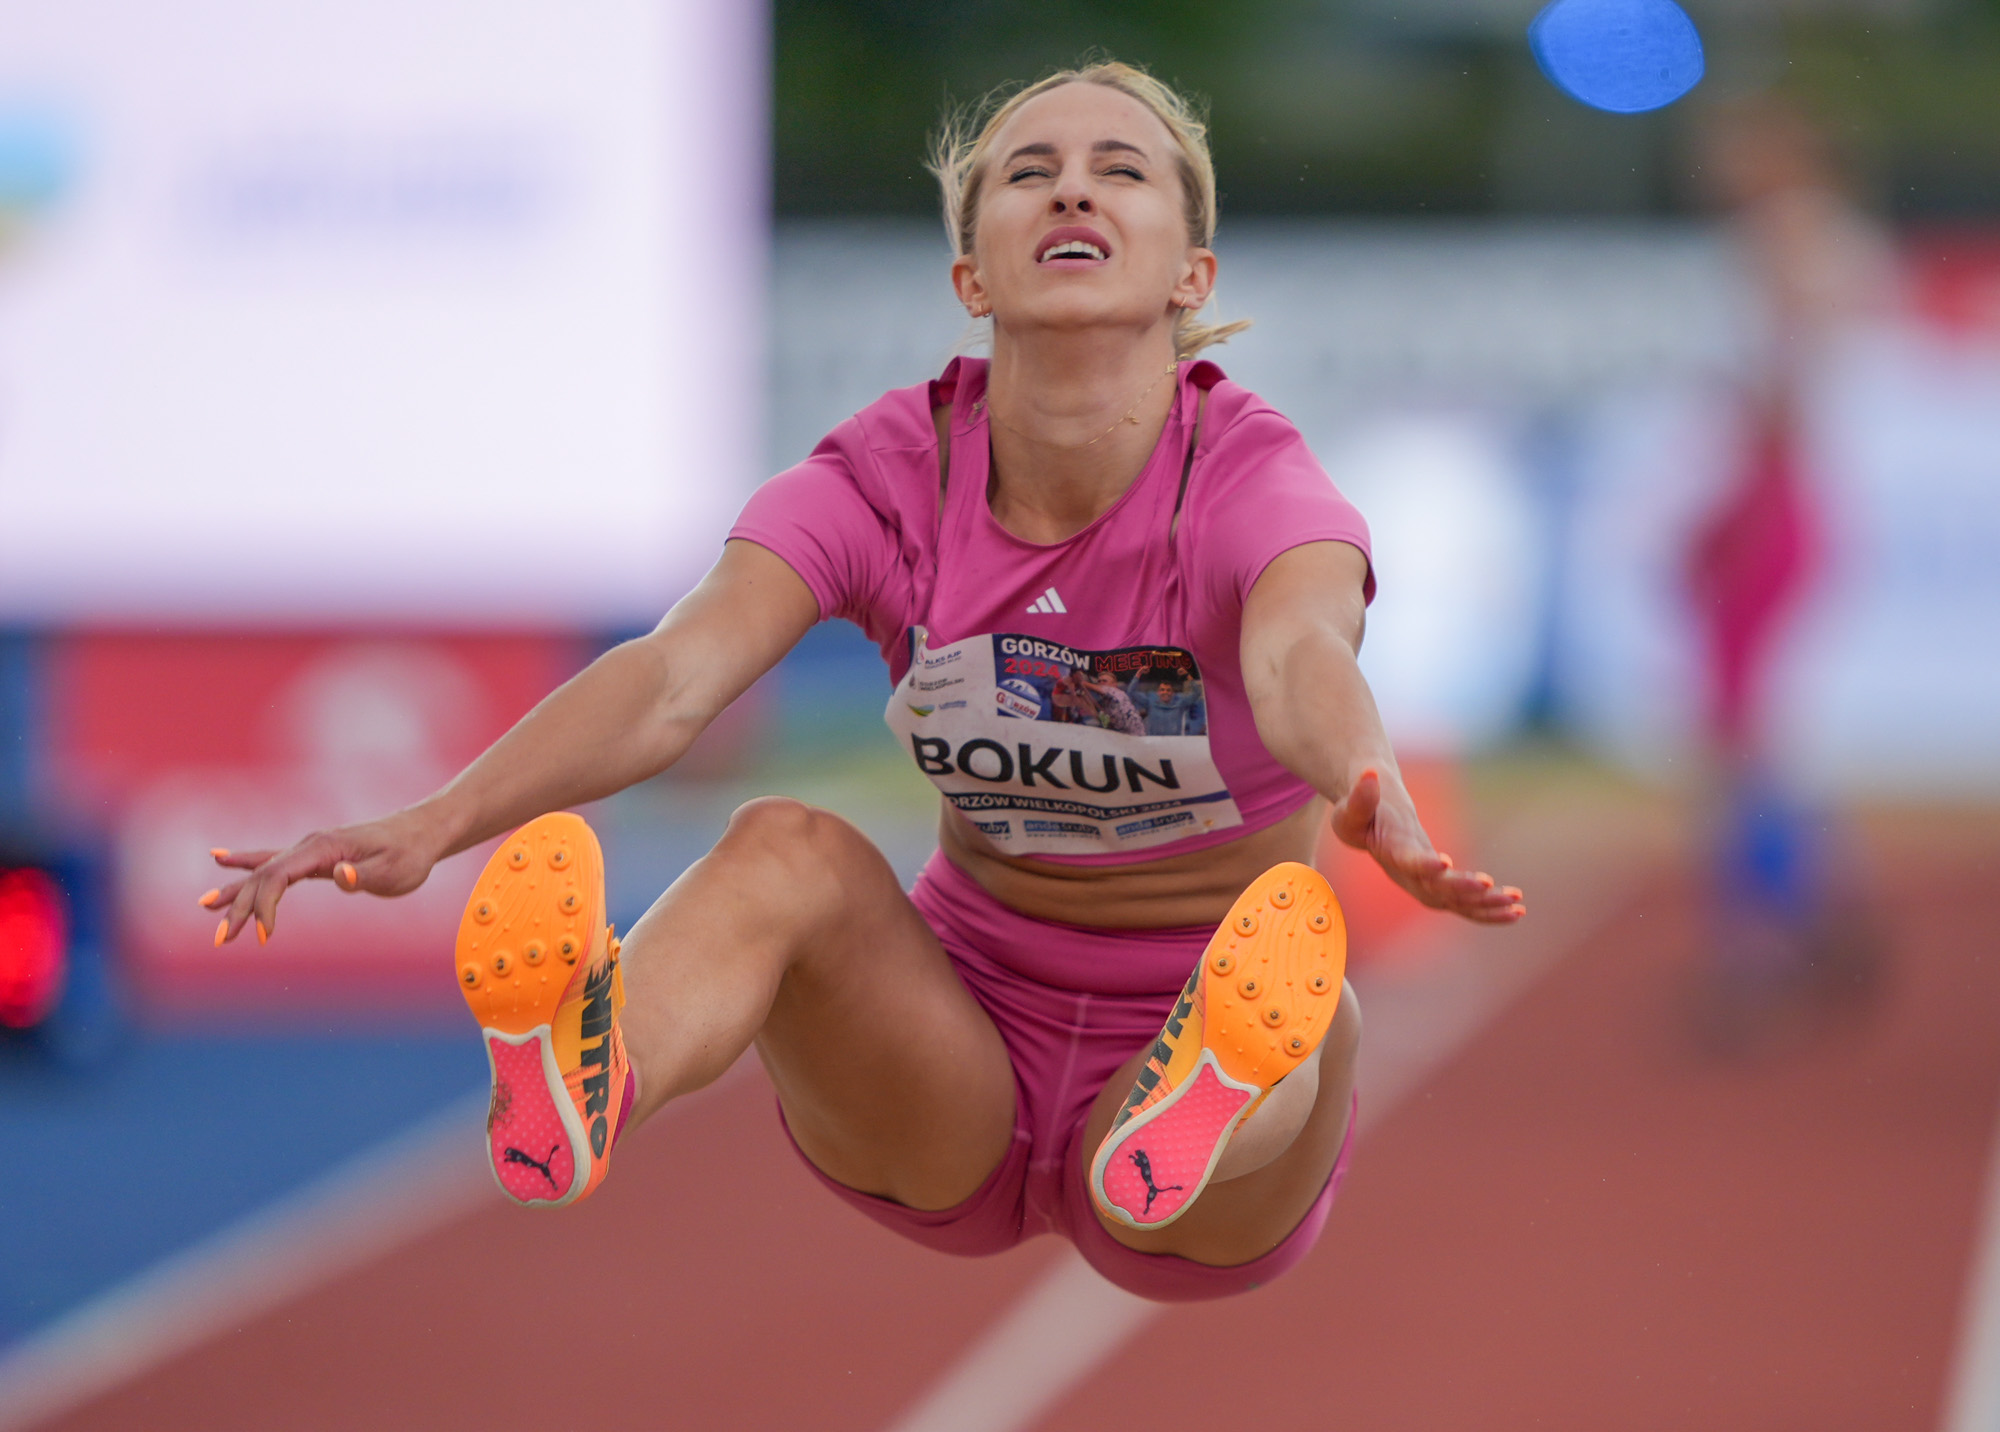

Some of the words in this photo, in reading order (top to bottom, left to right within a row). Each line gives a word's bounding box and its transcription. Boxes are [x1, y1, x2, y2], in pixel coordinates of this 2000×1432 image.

[1001, 637, 1090, 669] GORZÓW
[1095, 650, 1193, 673] MEETING
[1004, 658, 1061, 679] 2024
[912, 734, 1180, 793] BOKUN
[951, 795, 1010, 808] ORZÓW
[1012, 797, 1136, 818] WIELKOPOLSKI
[580, 964, 613, 1160] NITRO
